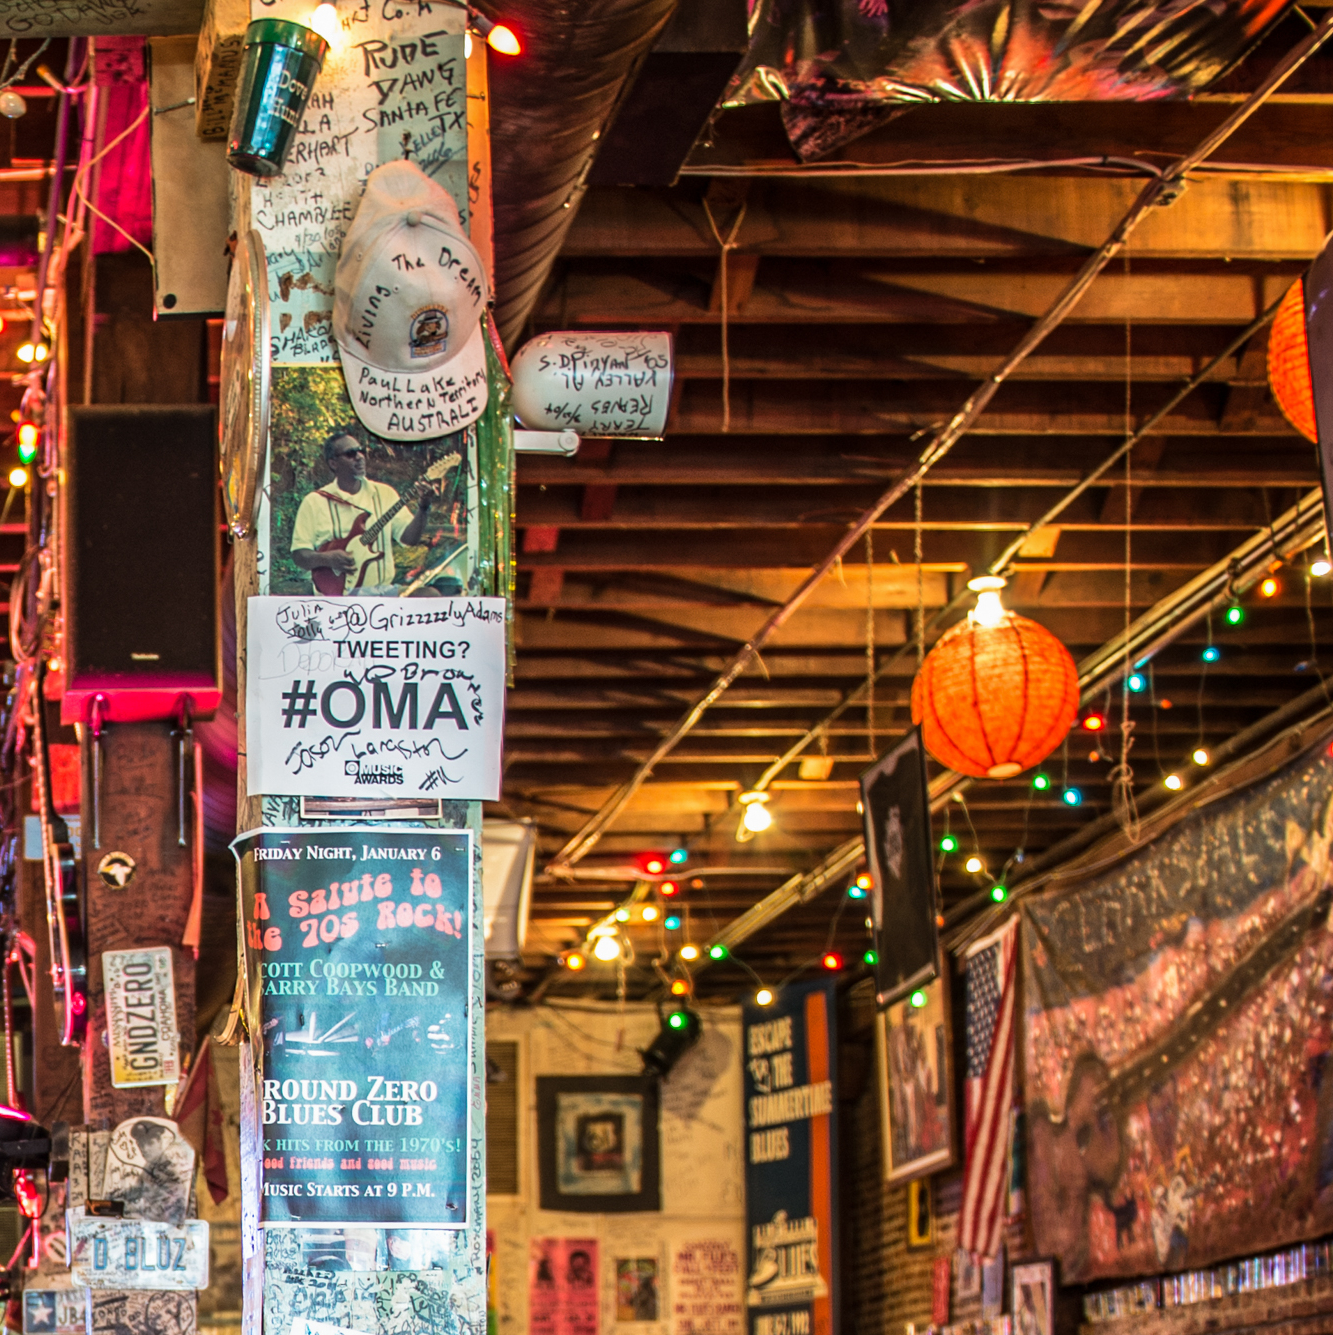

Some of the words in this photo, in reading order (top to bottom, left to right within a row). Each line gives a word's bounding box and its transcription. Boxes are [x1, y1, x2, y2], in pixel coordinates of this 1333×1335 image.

[351, 30, 448, 78] RUDE
[368, 58, 458, 106] DAWG
[433, 87, 464, 113] FE
[428, 110, 466, 134] TX
[355, 284, 392, 350] Living
[333, 640, 471, 660] TWEETING?
[281, 679, 470, 731] #OMA
[354, 775, 404, 785] AWARDS
[360, 764, 403, 776] MUSIC
[253, 846, 303, 863] FRIDAY
[306, 845, 357, 863] NIGHT,
[360, 846, 428, 863] JANUARY
[430, 846, 442, 861] 6
[252, 891, 271, 921] A
[288, 867, 393, 919] Salute
[409, 866, 442, 899] to
[246, 919, 283, 952] the
[261, 961, 304, 980] COTT
[308, 959, 423, 981] COOPWOOD
[430, 962, 446, 980] &
[325, 979, 378, 997] BAYS
[383, 979, 440, 998] BAND
[123, 961, 160, 1072] GNDZERO
[263, 1076, 358, 1102] ROUND
[366, 1076, 438, 1102] ZERO
[262, 1101, 343, 1126] BLUES
[351, 1101, 424, 1126] CLUB
[276, 1138, 311, 1152] HITS
[315, 1138, 360, 1153] FROM
[364, 1138, 394, 1153] THE
[264, 1156, 284, 1170] ood
[289, 1156, 336, 1171] friends
[340, 1157, 362, 1171] and
[399, 1157, 437, 1171] music
[263, 1183, 303, 1198] MUSIC
[306, 1183, 361, 1198] STARTS
[364, 1183, 383, 1198] AT
[387, 1183, 398, 1198] 9
[401, 1183, 436, 1198] P.M.
[125, 1238, 187, 1271] BLUZ
